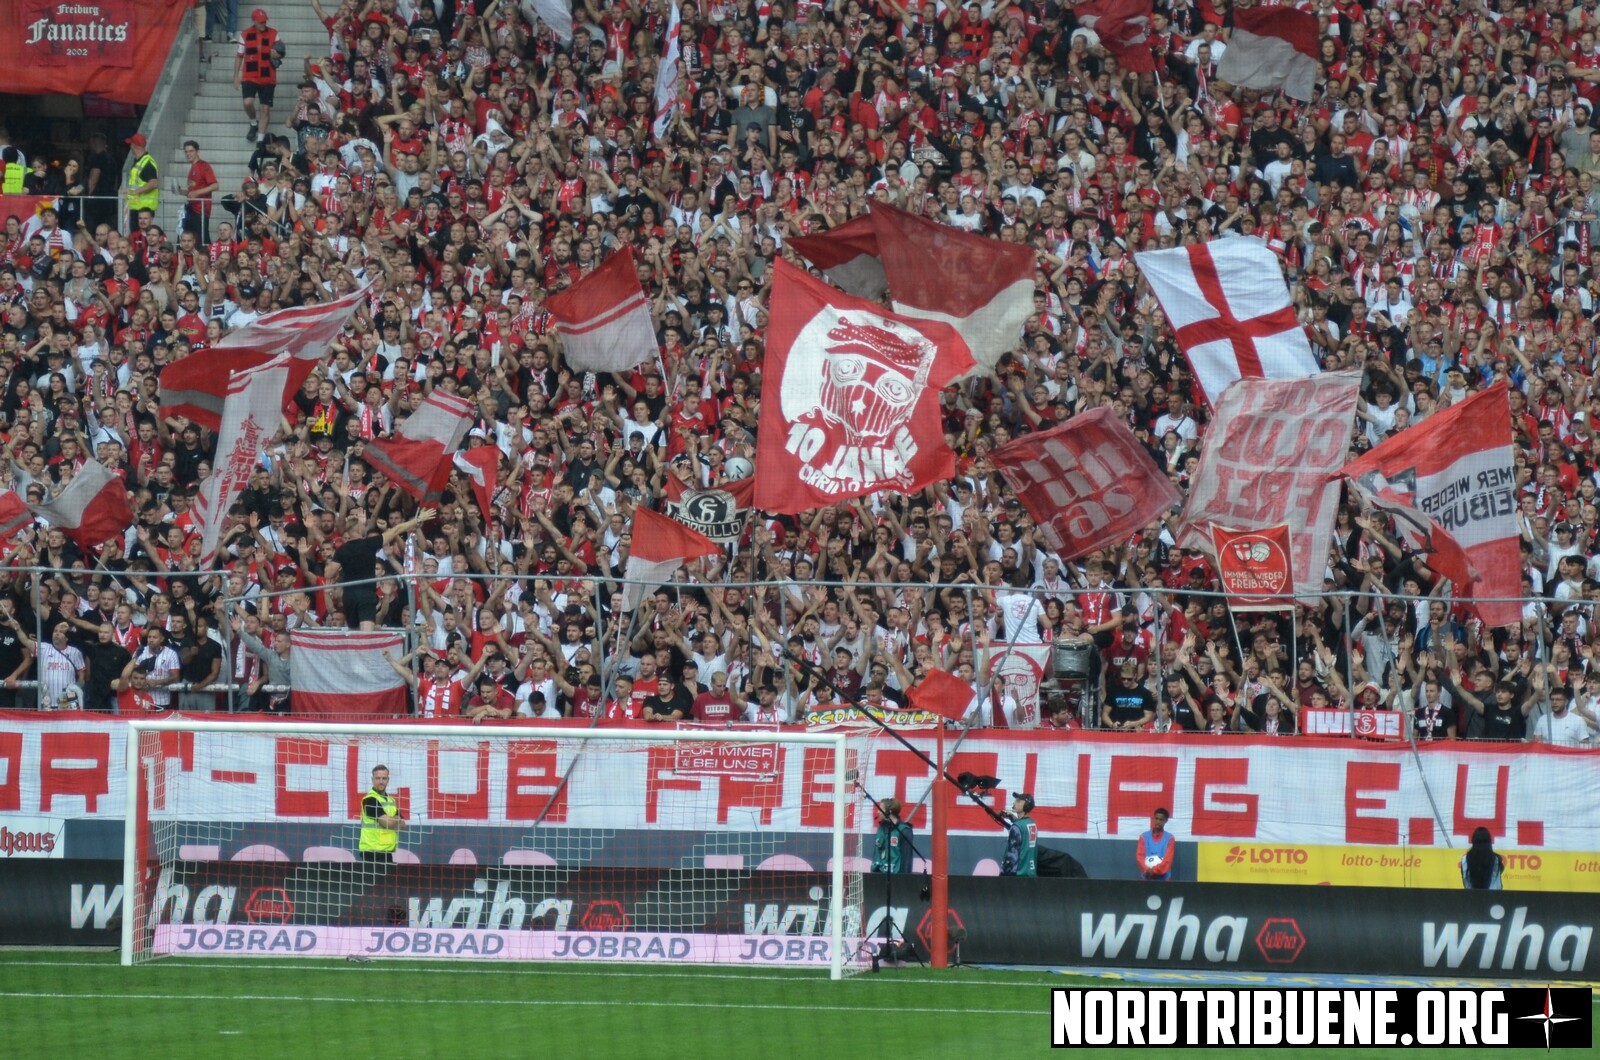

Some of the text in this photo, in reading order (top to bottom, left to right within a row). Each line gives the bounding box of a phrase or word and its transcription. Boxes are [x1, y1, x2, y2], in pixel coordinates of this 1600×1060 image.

[57, 4, 99, 16] Freiburg
[25, 18, 128, 44] Fanatics
[66, 48, 88, 56] 2002
[785, 423, 826, 463] 10
[821, 425, 918, 482] JAHRE
[693, 759, 758, 769] BEI UNS
[718, 747, 773, 758] IMMER
[1250, 848, 1308, 865] LOTTO
[1341, 854, 1422, 868] lotto-bw.de
[408, 879, 573, 931] wiha
[177, 928, 317, 951] JOBRAD
[1081, 895, 1248, 963] wiha
[1422, 904, 1594, 972] wiha
[365, 930, 504, 955] JOBRAD
[552, 935, 691, 959] JOBRAD
